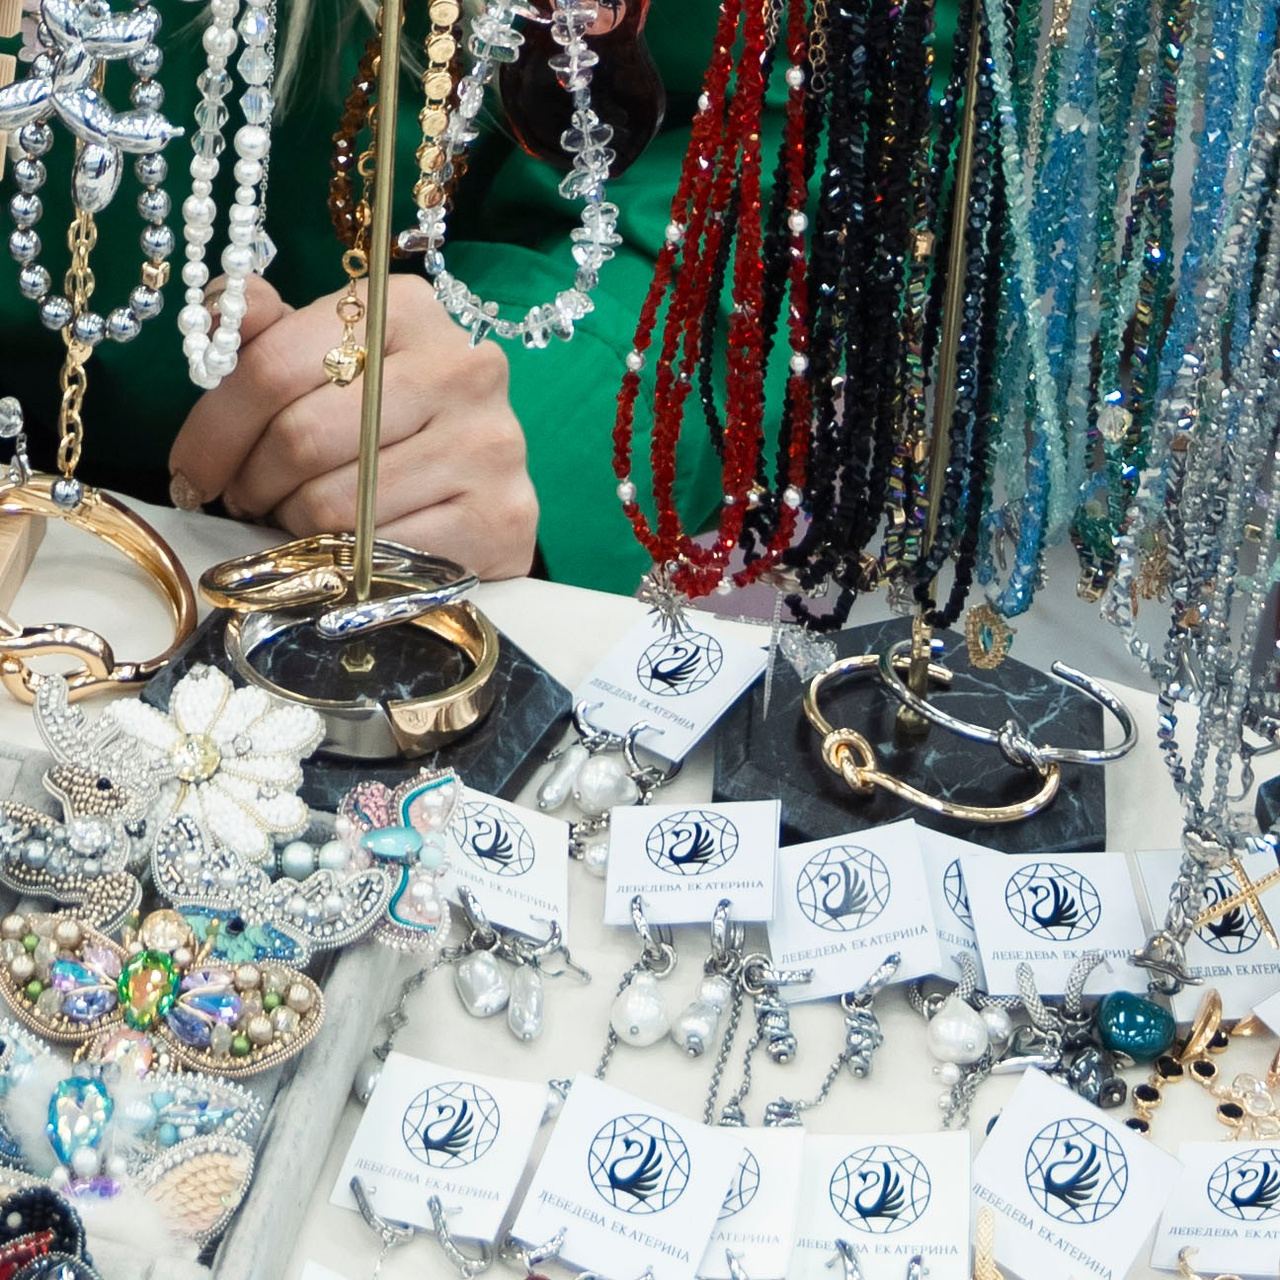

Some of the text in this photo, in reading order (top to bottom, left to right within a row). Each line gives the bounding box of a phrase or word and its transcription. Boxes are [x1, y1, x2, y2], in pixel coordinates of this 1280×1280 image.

[590, 678, 696, 731] ЛЕБЕДЕВА ЕКАТЕРИНА
[489, 880, 559, 912] ЕКАТЕРИНА
[616, 880, 764, 894] ЛЕБЕДЕВА ЕКАТЕРИНА
[781, 924, 928, 964] ЛЕБЕДЕВА ЕКАТЕРИНА
[992, 950, 1058, 960] ЛЕБЕДЕВА
[354, 1157, 500, 1201] ЛЕБЕДЕВА ЕКАТЕРИНА
[538, 1190, 690, 1263] ЛЕБЕДЕВА ЕКАТЕРИНА
[972, 1182, 1113, 1280] ЛЕБЕДЕВА ЕКАТЕРИНА
[1169, 1226, 1280, 1239] ЛЕБЕДЕВА ЕКАТ
[797, 1238, 959, 1255] ЛЕБЕВА ЕКАТЕРИНА
